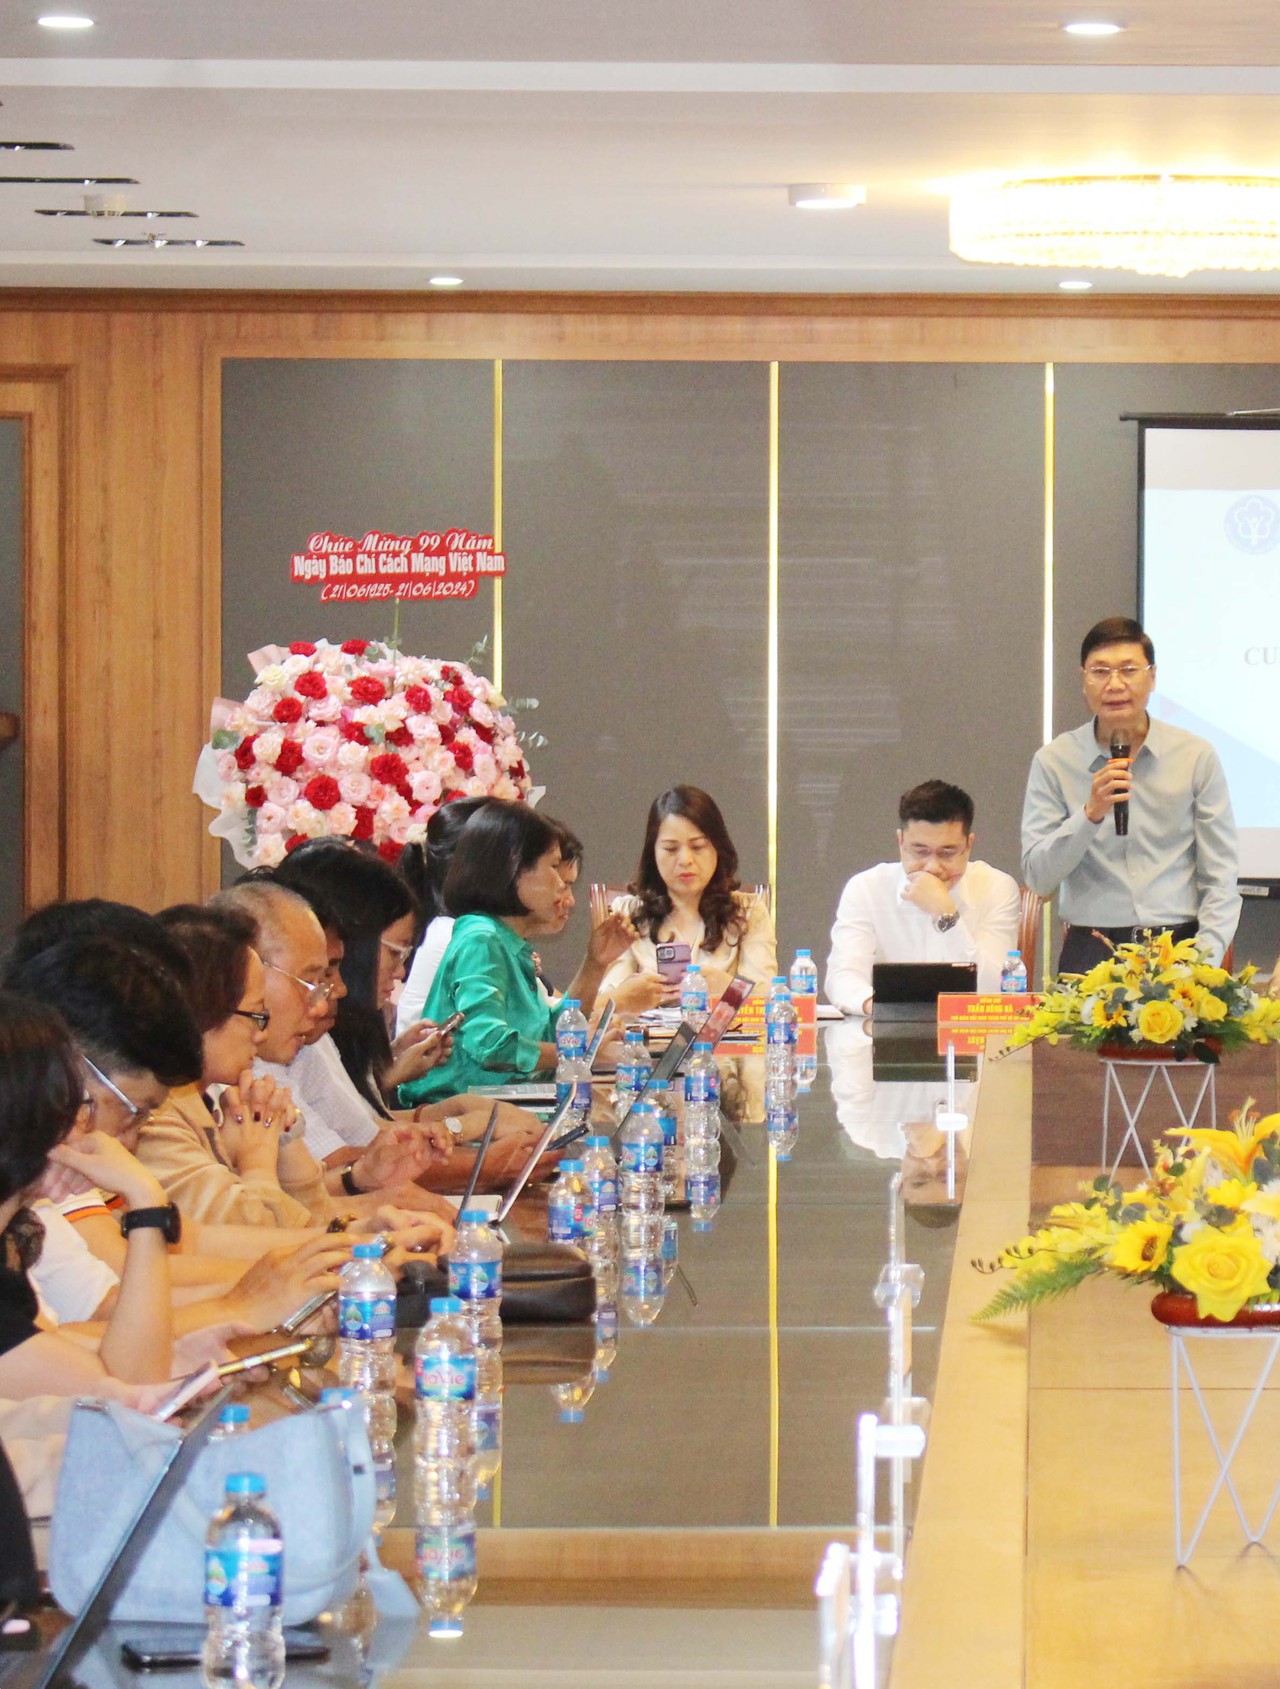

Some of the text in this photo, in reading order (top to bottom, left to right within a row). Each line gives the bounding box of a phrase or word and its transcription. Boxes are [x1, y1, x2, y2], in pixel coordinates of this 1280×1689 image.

[418, 534, 441, 551] 99
[446, 532, 495, 551] Năm
[294, 551, 505, 579] Ngày Báo Chí Cách Mạng Việt Nam
